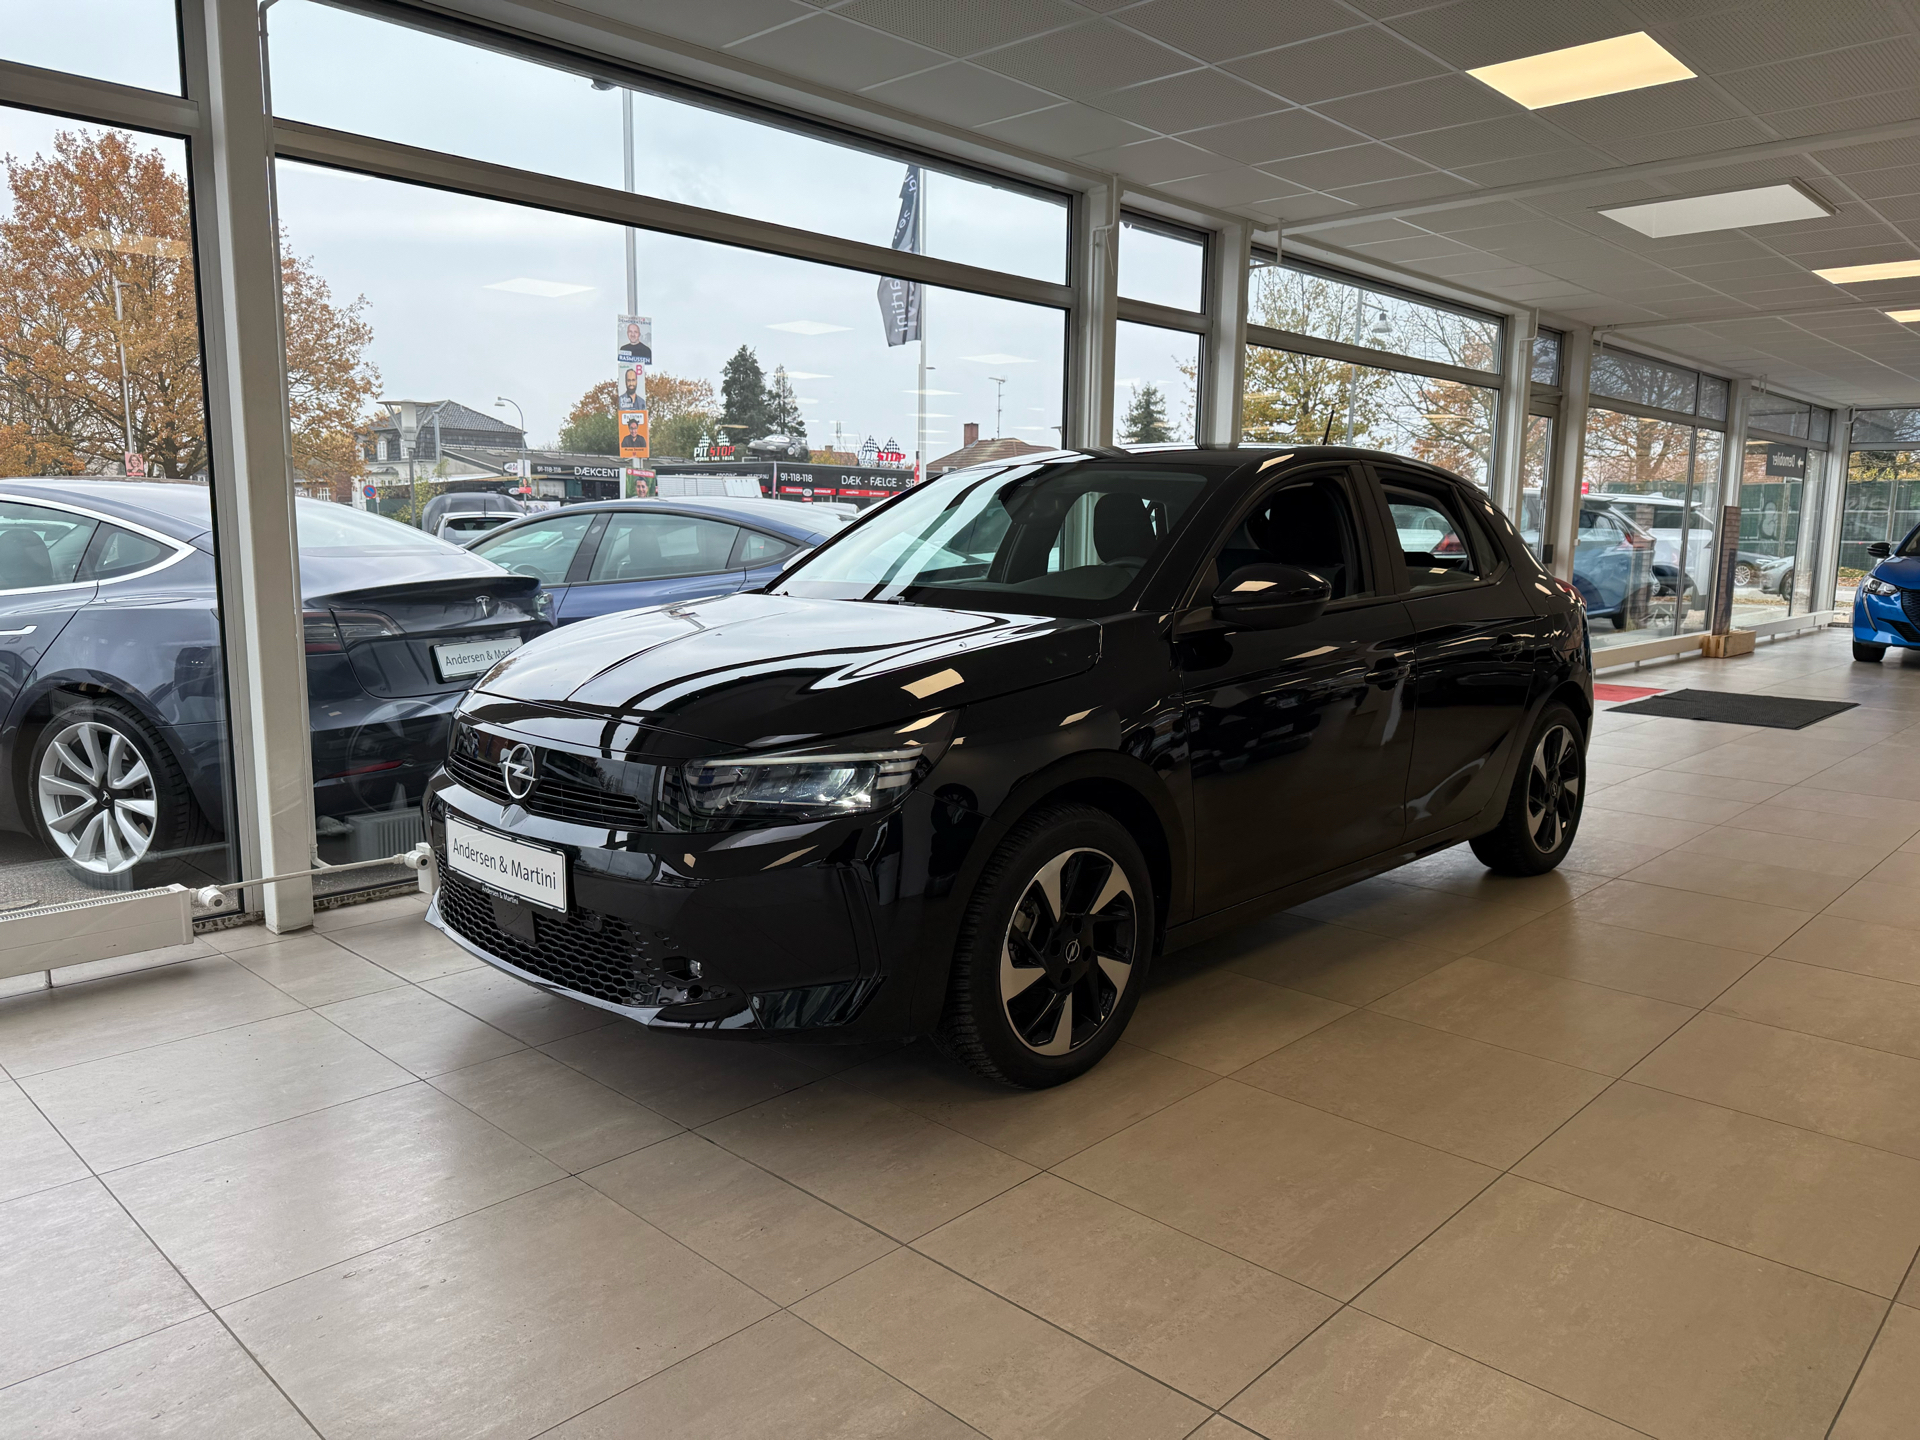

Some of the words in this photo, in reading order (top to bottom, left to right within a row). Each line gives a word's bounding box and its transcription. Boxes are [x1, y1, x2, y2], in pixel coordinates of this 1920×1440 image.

[618, 355, 651, 364] RASMUSSEN
[636, 364, 643, 376] B
[694, 447, 709, 457] PIT
[709, 445, 736, 457] STOP
[878, 452, 906, 463] STOP
[780, 472, 813, 483] 91-118-118
[841, 475, 862, 486] DÆK
[869, 476, 897, 488] FÆLGE
[445, 653, 486, 666] Andersen
[487, 650, 494, 661] &
[453, 838, 497, 870] Andersen
[499, 855, 508, 875] &
[511, 859, 556, 890] Martini
[481, 885, 500, 898] Andersen
[503, 893, 519, 905] Martini
